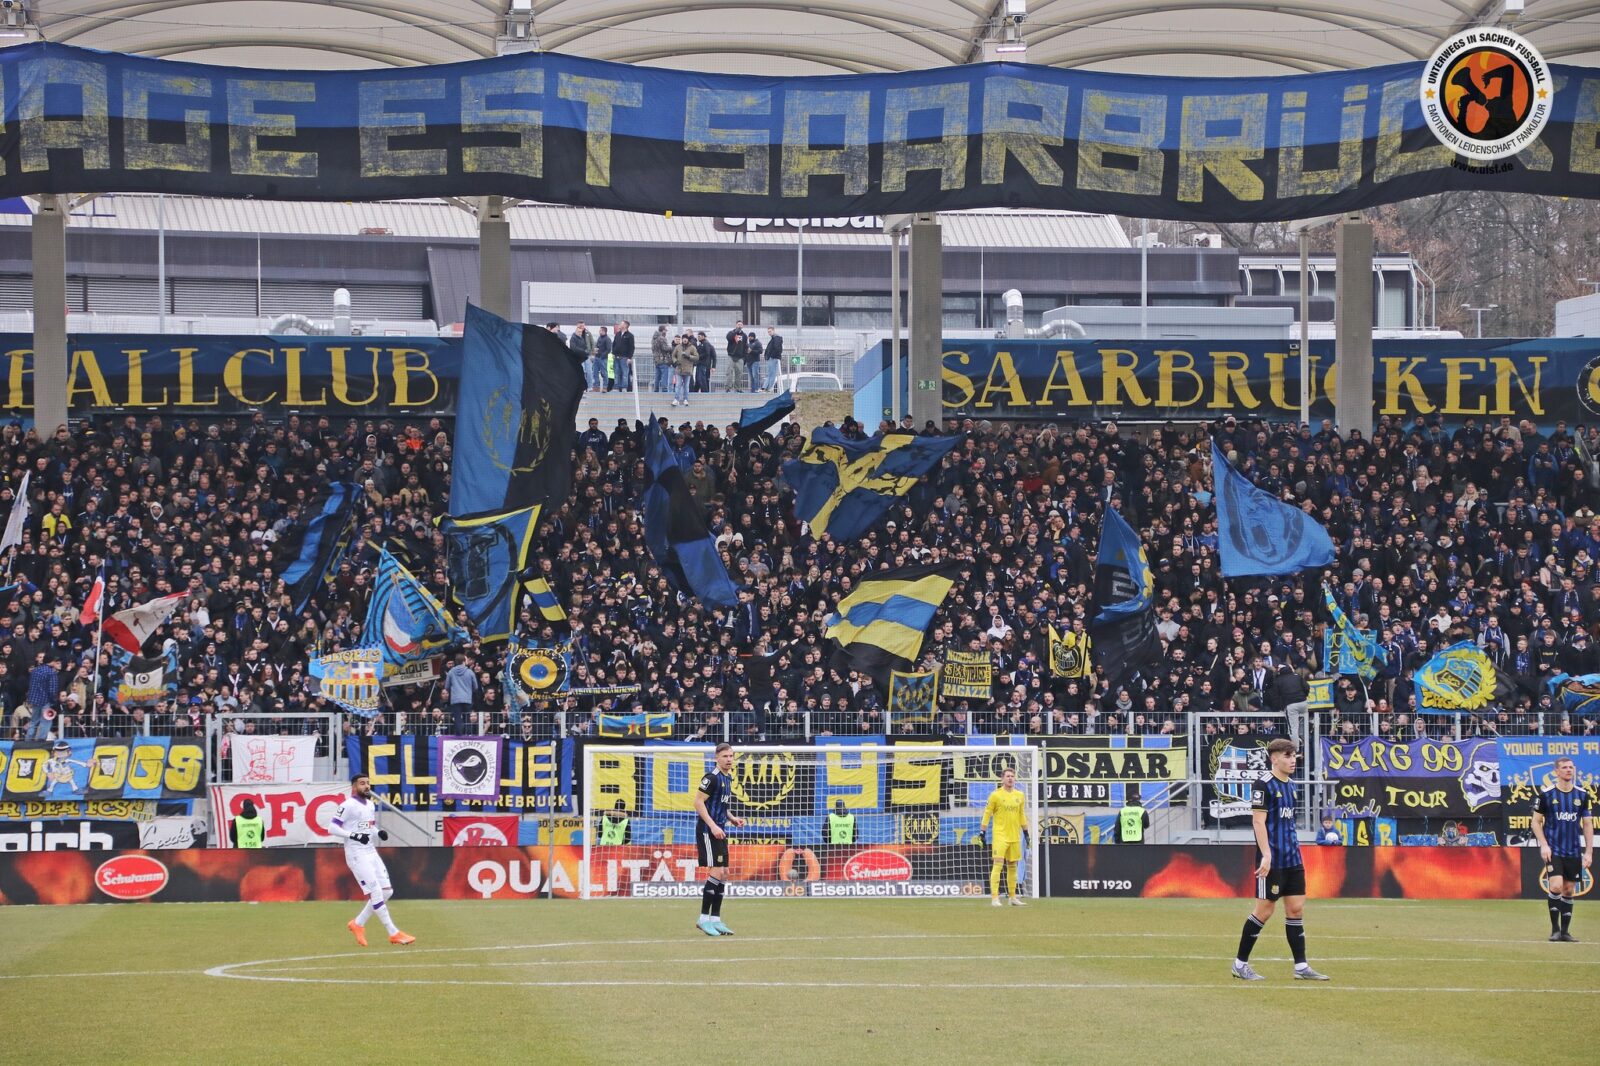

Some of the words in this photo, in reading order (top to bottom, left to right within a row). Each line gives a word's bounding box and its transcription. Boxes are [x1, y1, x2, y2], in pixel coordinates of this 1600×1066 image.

[358, 67, 642, 188] EST
[1329, 741, 1412, 772] SARG
[1420, 743, 1463, 773] 99
[1503, 743, 1543, 756] YOUNG
[1547, 743, 1579, 755] BOYS
[1583, 741, 1600, 754] 99
[1340, 784, 1365, 798] ON
[1385, 786, 1449, 809] TOUR
[25, 800, 79, 817] DER
[811, 883, 896, 897] Eisenbach
[898, 882, 983, 896] Tresore.de
[1073, 879, 1098, 890] SEIT
[1102, 879, 1132, 890] 1920
